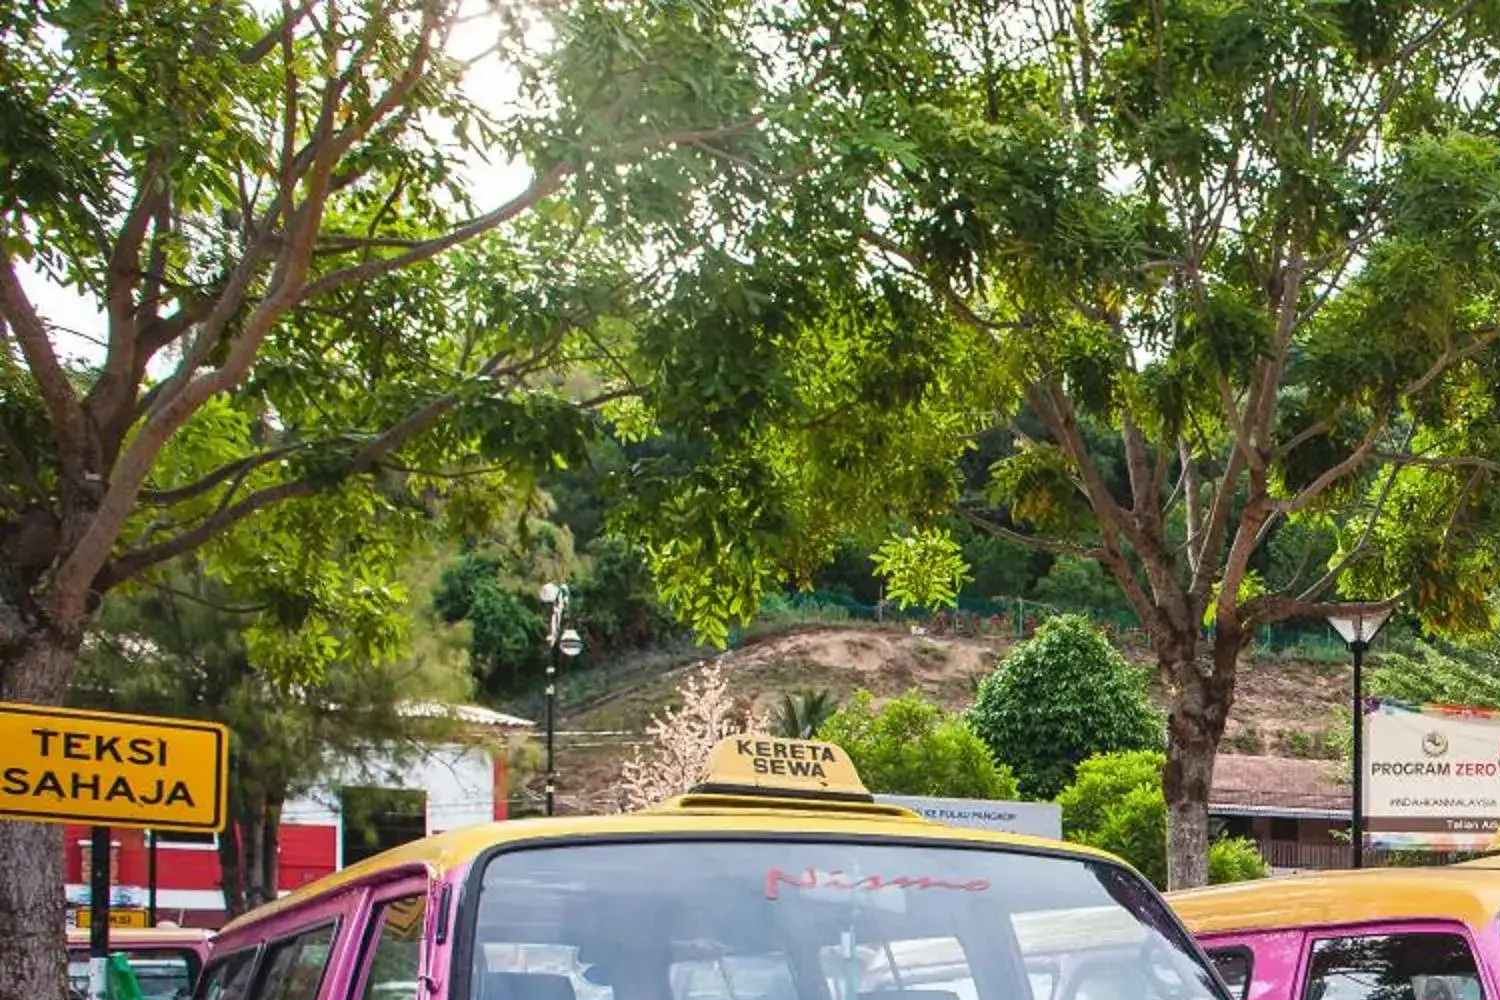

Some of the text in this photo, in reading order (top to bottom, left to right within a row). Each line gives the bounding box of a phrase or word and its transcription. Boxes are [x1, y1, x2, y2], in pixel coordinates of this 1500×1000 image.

[32, 728, 167, 766] TEKSI
[736, 739, 836, 762] KERETA
[753, 758, 827, 778] SEWA
[1371, 762, 1450, 776] PROGRAM
[1455, 763, 1497, 776] ZERO
[3, 768, 195, 807] SAHAJA
